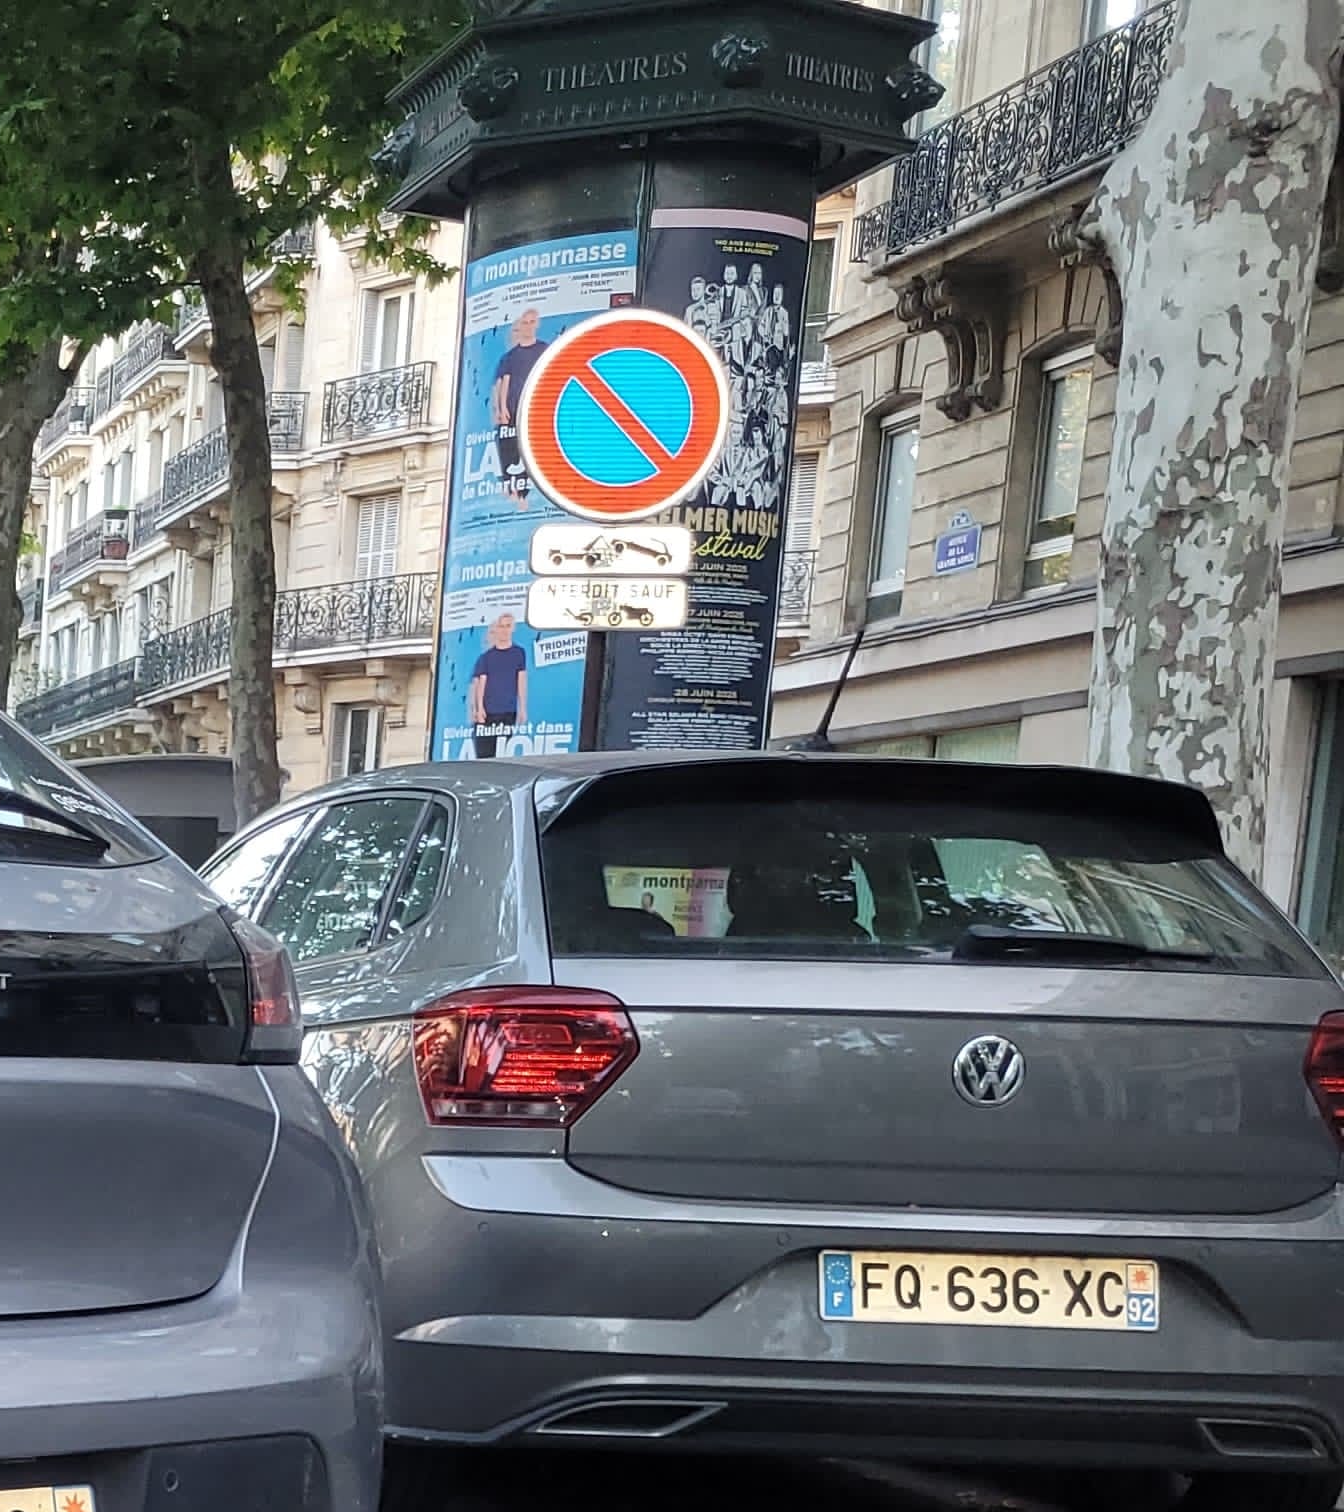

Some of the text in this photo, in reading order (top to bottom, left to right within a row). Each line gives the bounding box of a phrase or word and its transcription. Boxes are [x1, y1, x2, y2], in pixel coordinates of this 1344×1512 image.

[543, 52, 687, 92] THEATRES
[785, 53, 874, 93] THEATRES
[485, 242, 627, 282] montparnasse
[463, 440, 504, 485] LA
[649, 507, 779, 538] ELMER MUSIC
[690, 529, 769, 560] estival
[630, 583, 678, 599] SAUF
[475, 722, 532, 737] Ruidavet
[535, 720, 574, 734] dans
[861, 1262, 1125, 1319] FQ-636-XC
[1127, 1297, 1156, 1323] 92
